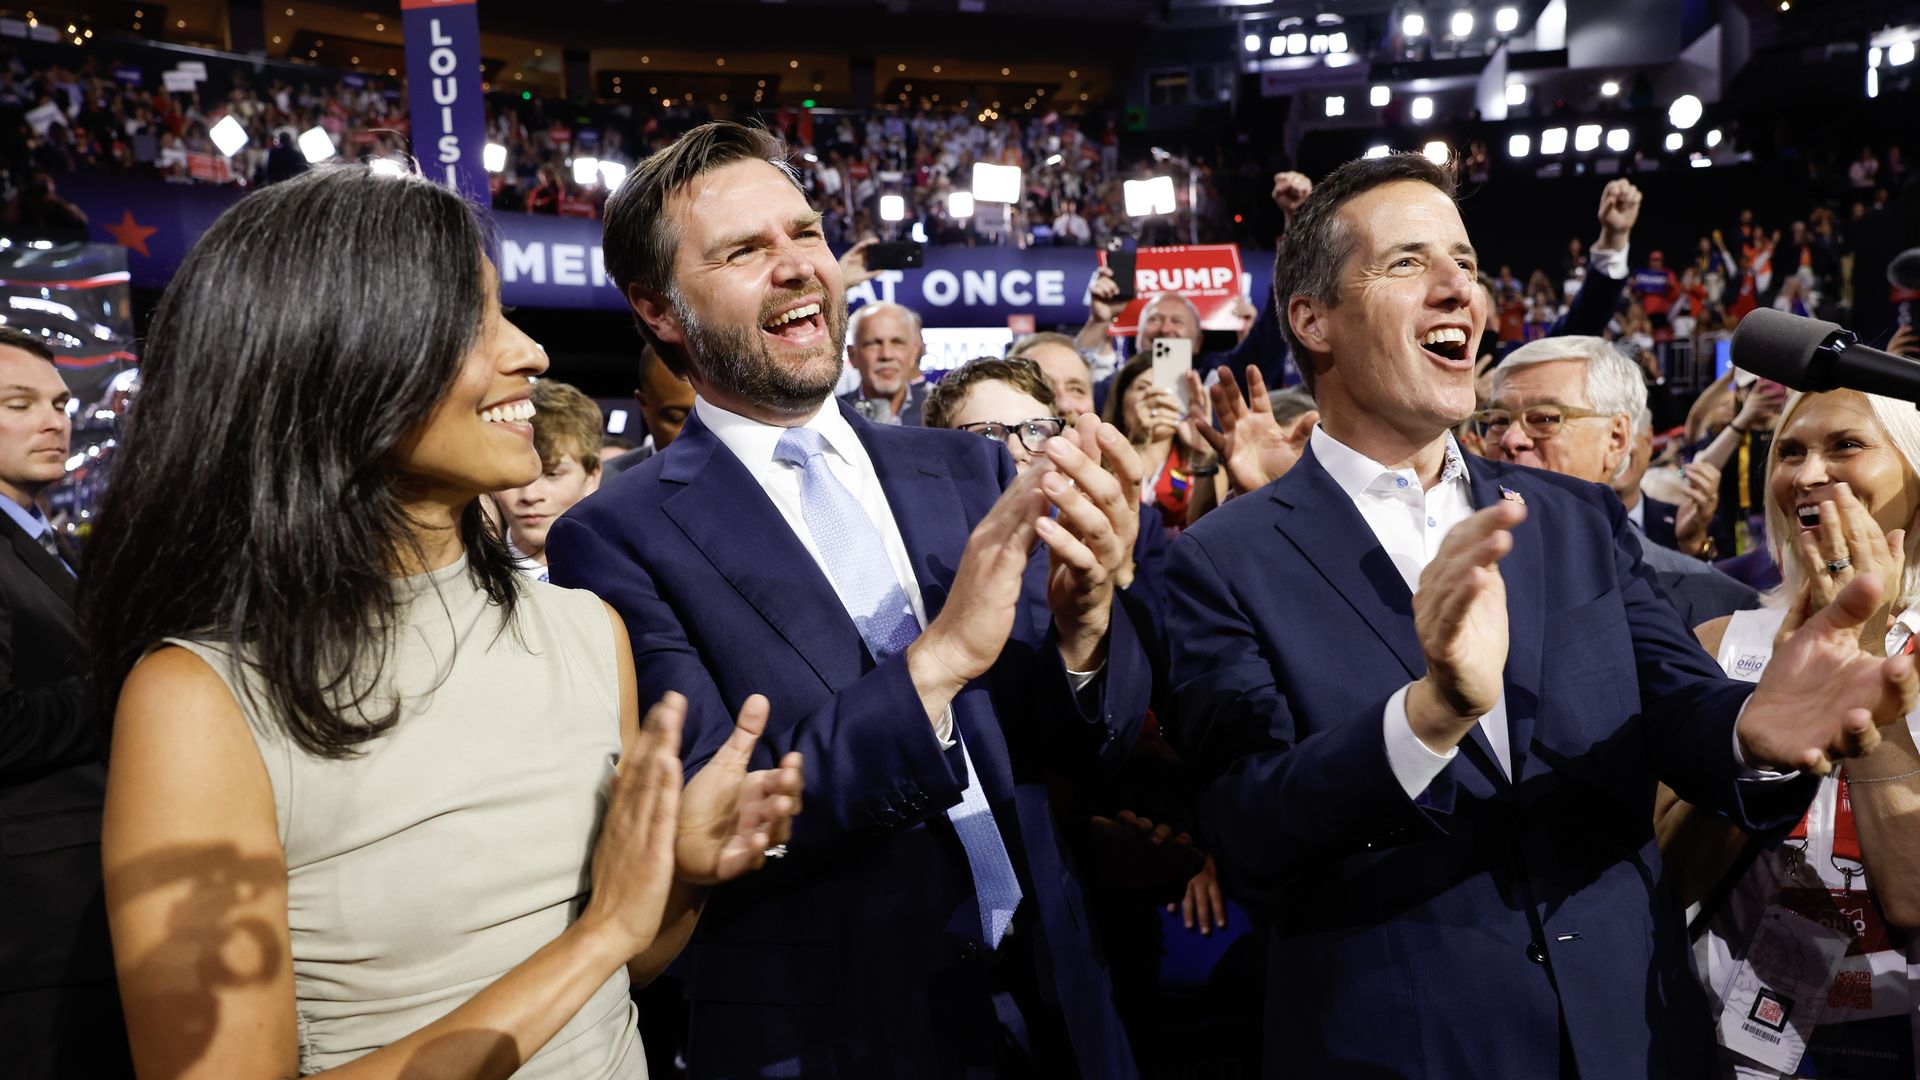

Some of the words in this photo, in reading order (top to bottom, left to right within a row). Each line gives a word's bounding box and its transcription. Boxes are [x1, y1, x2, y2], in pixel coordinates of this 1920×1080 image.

[429, 18, 461, 192] LOUISI
[922, 269, 1066, 307] ONCE
[1136, 266, 1234, 293] RUMP
[1737, 660, 1763, 669] OHIO
